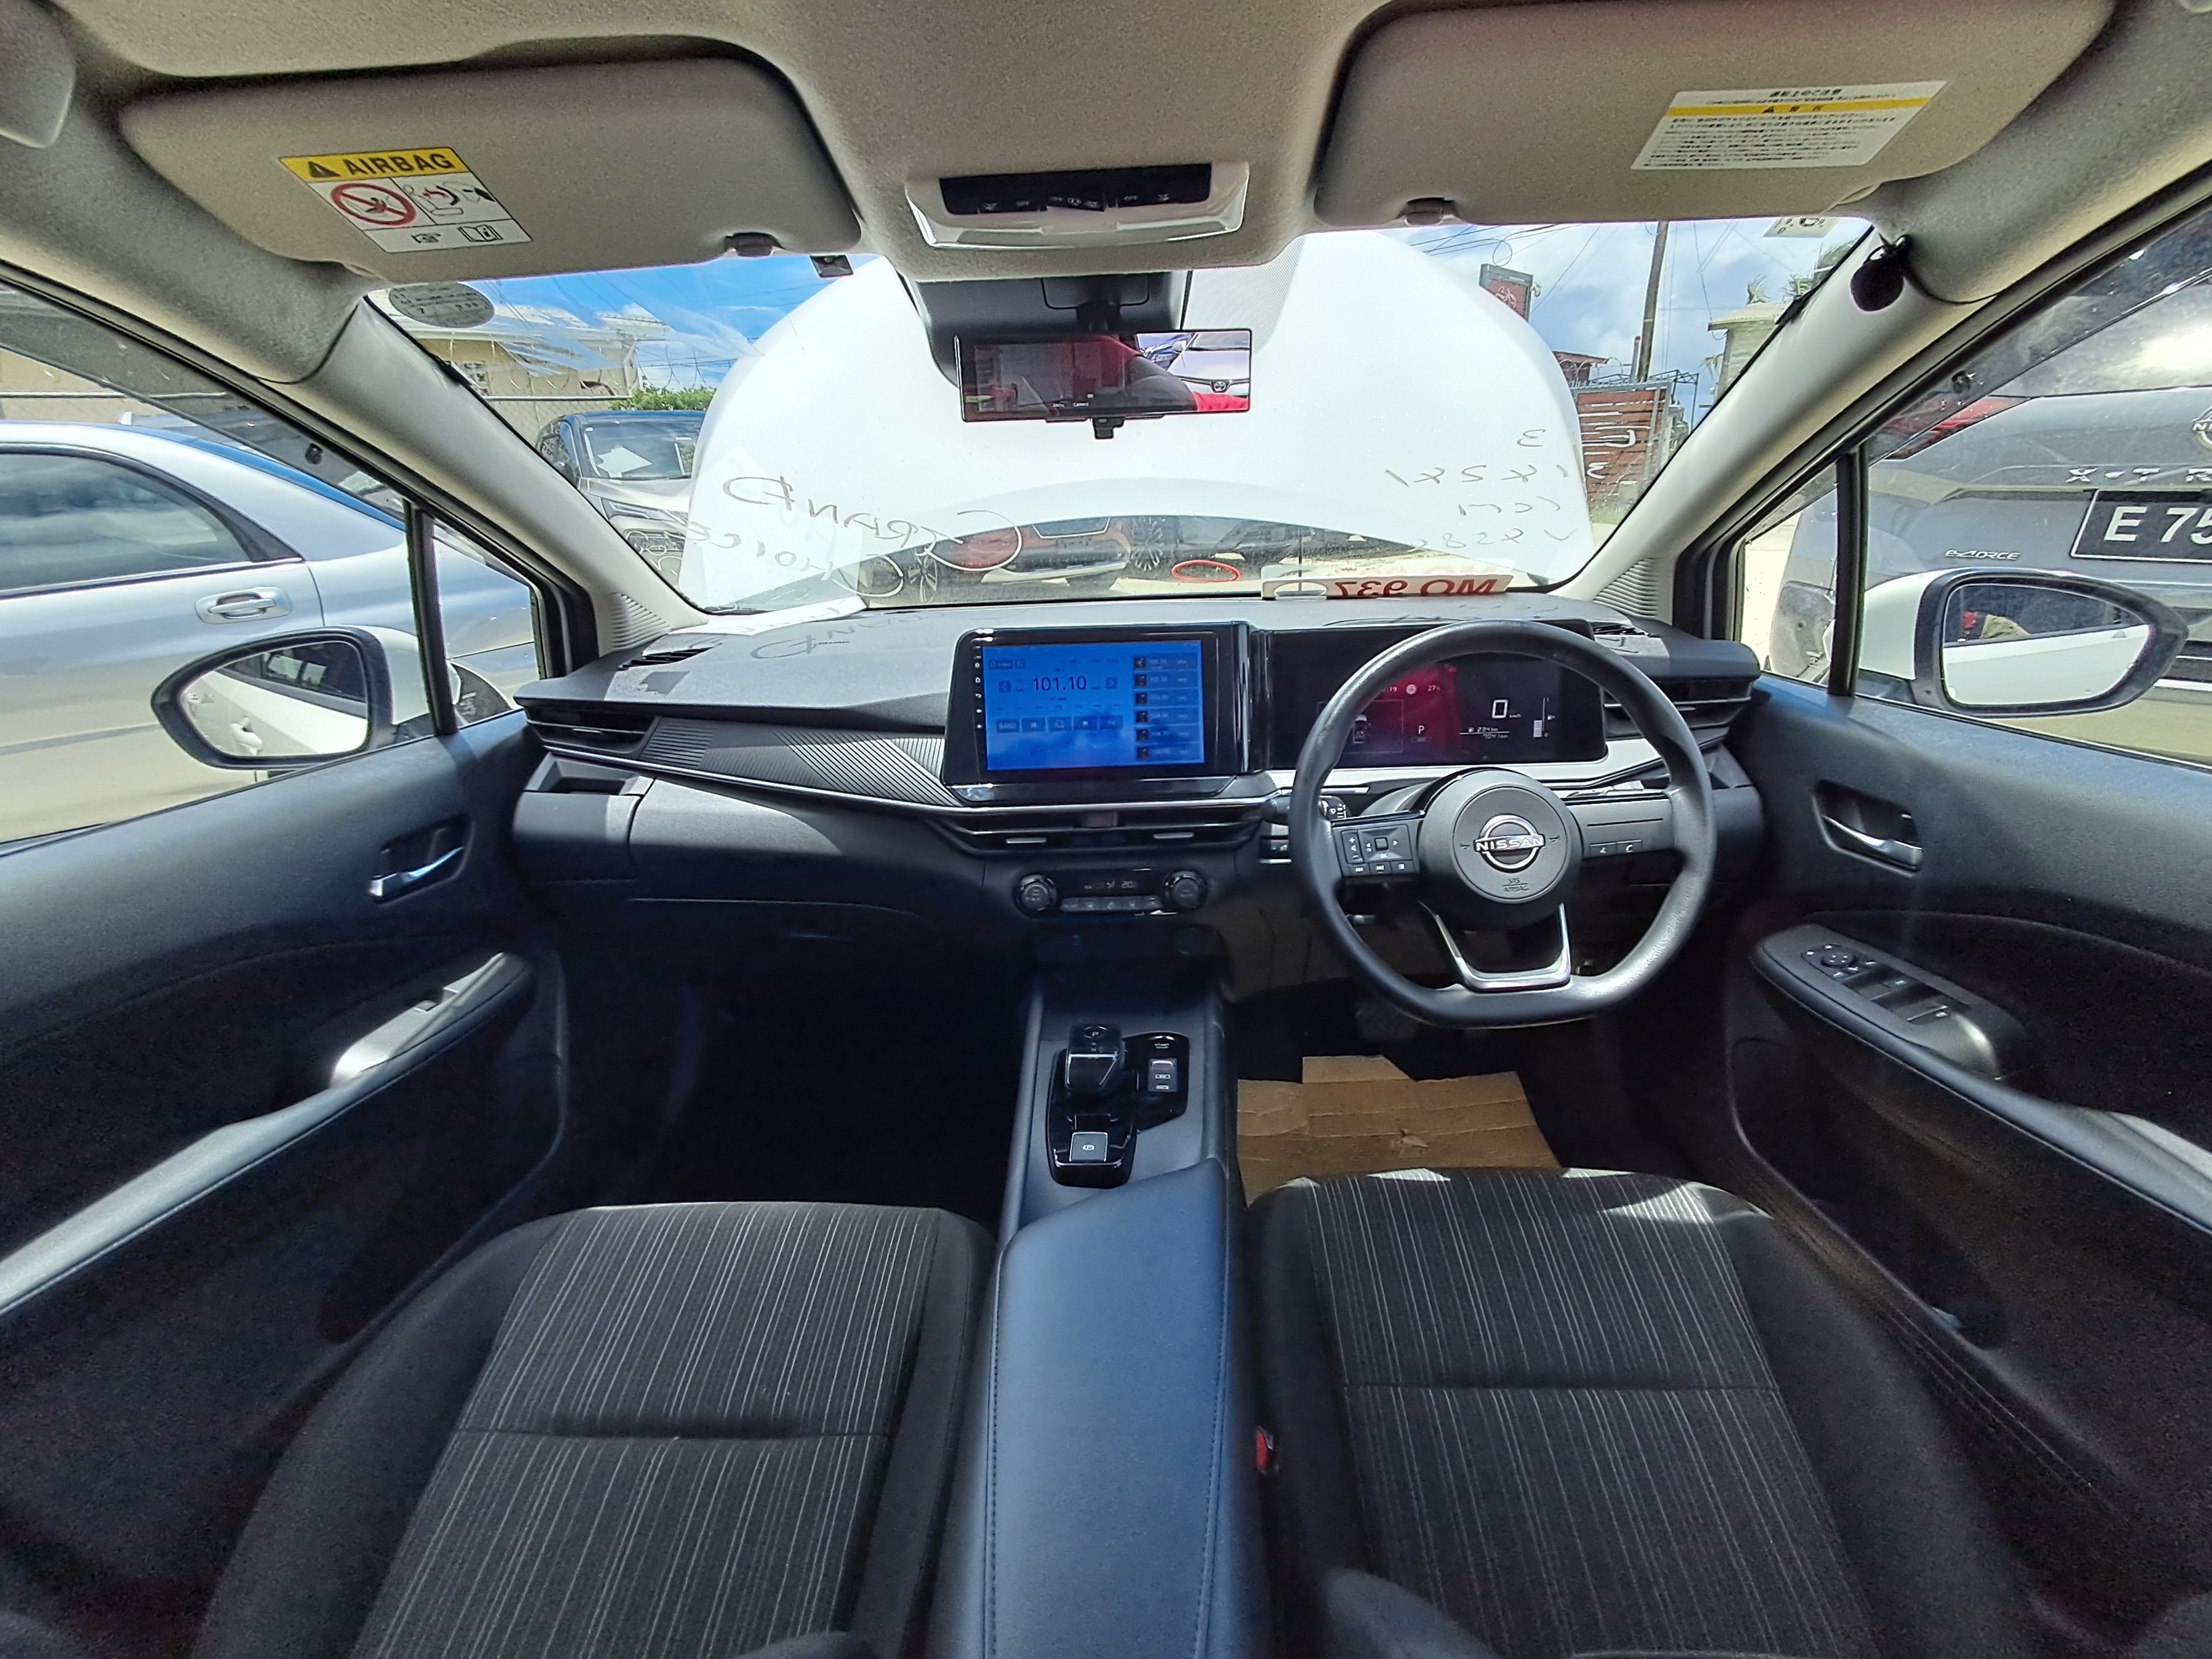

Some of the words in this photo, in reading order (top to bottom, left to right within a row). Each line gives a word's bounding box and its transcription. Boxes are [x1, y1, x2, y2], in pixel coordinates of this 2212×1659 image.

[342, 152, 456, 176] AIRBAG
[2103, 506, 2148, 541] E
[1032, 674, 1087, 691] 101.10
[1492, 699, 1509, 719] 0
[1418, 724, 1425, 735] P
[1475, 836, 1544, 851] NISSAN
